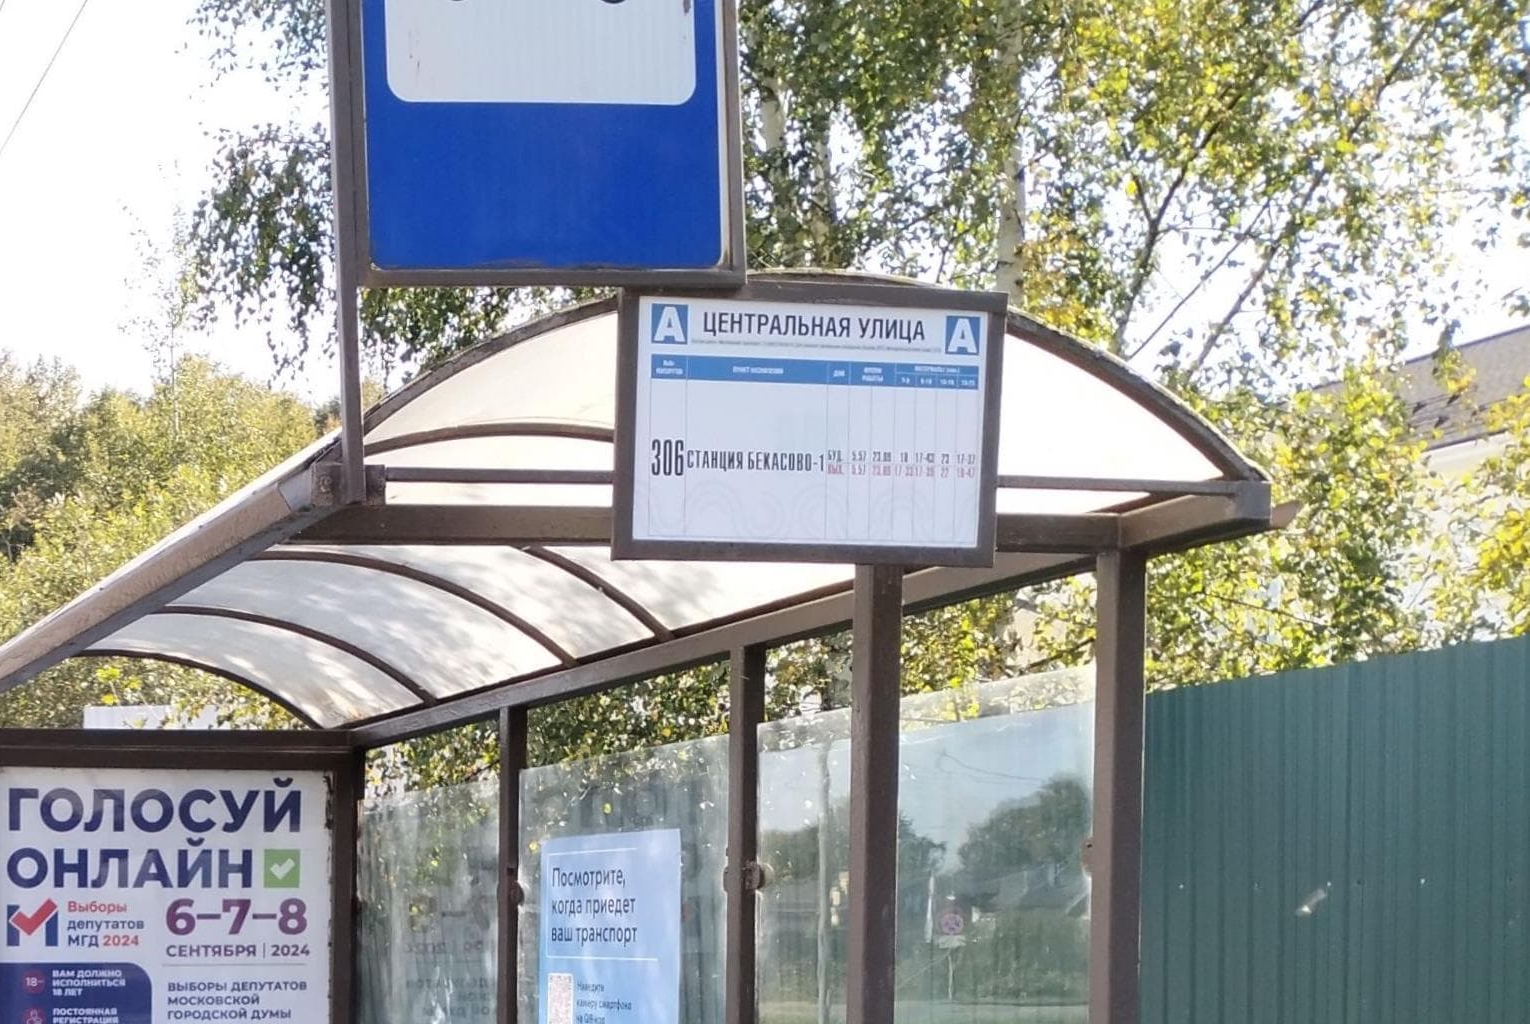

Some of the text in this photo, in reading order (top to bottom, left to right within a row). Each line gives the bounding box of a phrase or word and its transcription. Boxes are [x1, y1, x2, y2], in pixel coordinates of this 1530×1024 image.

[703, 311, 926, 342] ЦЕНТРАЛЬНАЯ УЛИЦА
[651, 439, 684, 477] 306
[686, 450, 824, 472] СТАНЦИЯ БЕКАСОВО-1
[8, 777, 301, 833] ГОЛОСУЙ
[6, 837, 253, 889] ОНЛАЙН
[551, 867, 626, 889] Посмотрите,
[67, 901, 127, 915] Выборы
[551, 897, 636, 917] когда приедет
[67, 919, 145, 932] депутатов
[68, 934, 139, 950] МГД 2024
[551, 925, 638, 946] ваш транспорт
[166, 944, 310, 958] СЕНТЯБРЯ 2024
[77, 970, 122, 978] ДОЛЖНО
[52, 979, 126, 987] ИСПОЛНИТЬСЯ
[168, 981, 308, 993] ВЫБОРЫ ДЕПУТАТОВ
[64, 988, 83, 996] ЛЕТ
[168, 994, 261, 1006] МОСКОВСКОЙ
[53, 1017, 119, 1024] РЕГИСТРАЦИЯ
[168, 1007, 292, 1021] ГОРОДСКОЙ ДУМЫ
